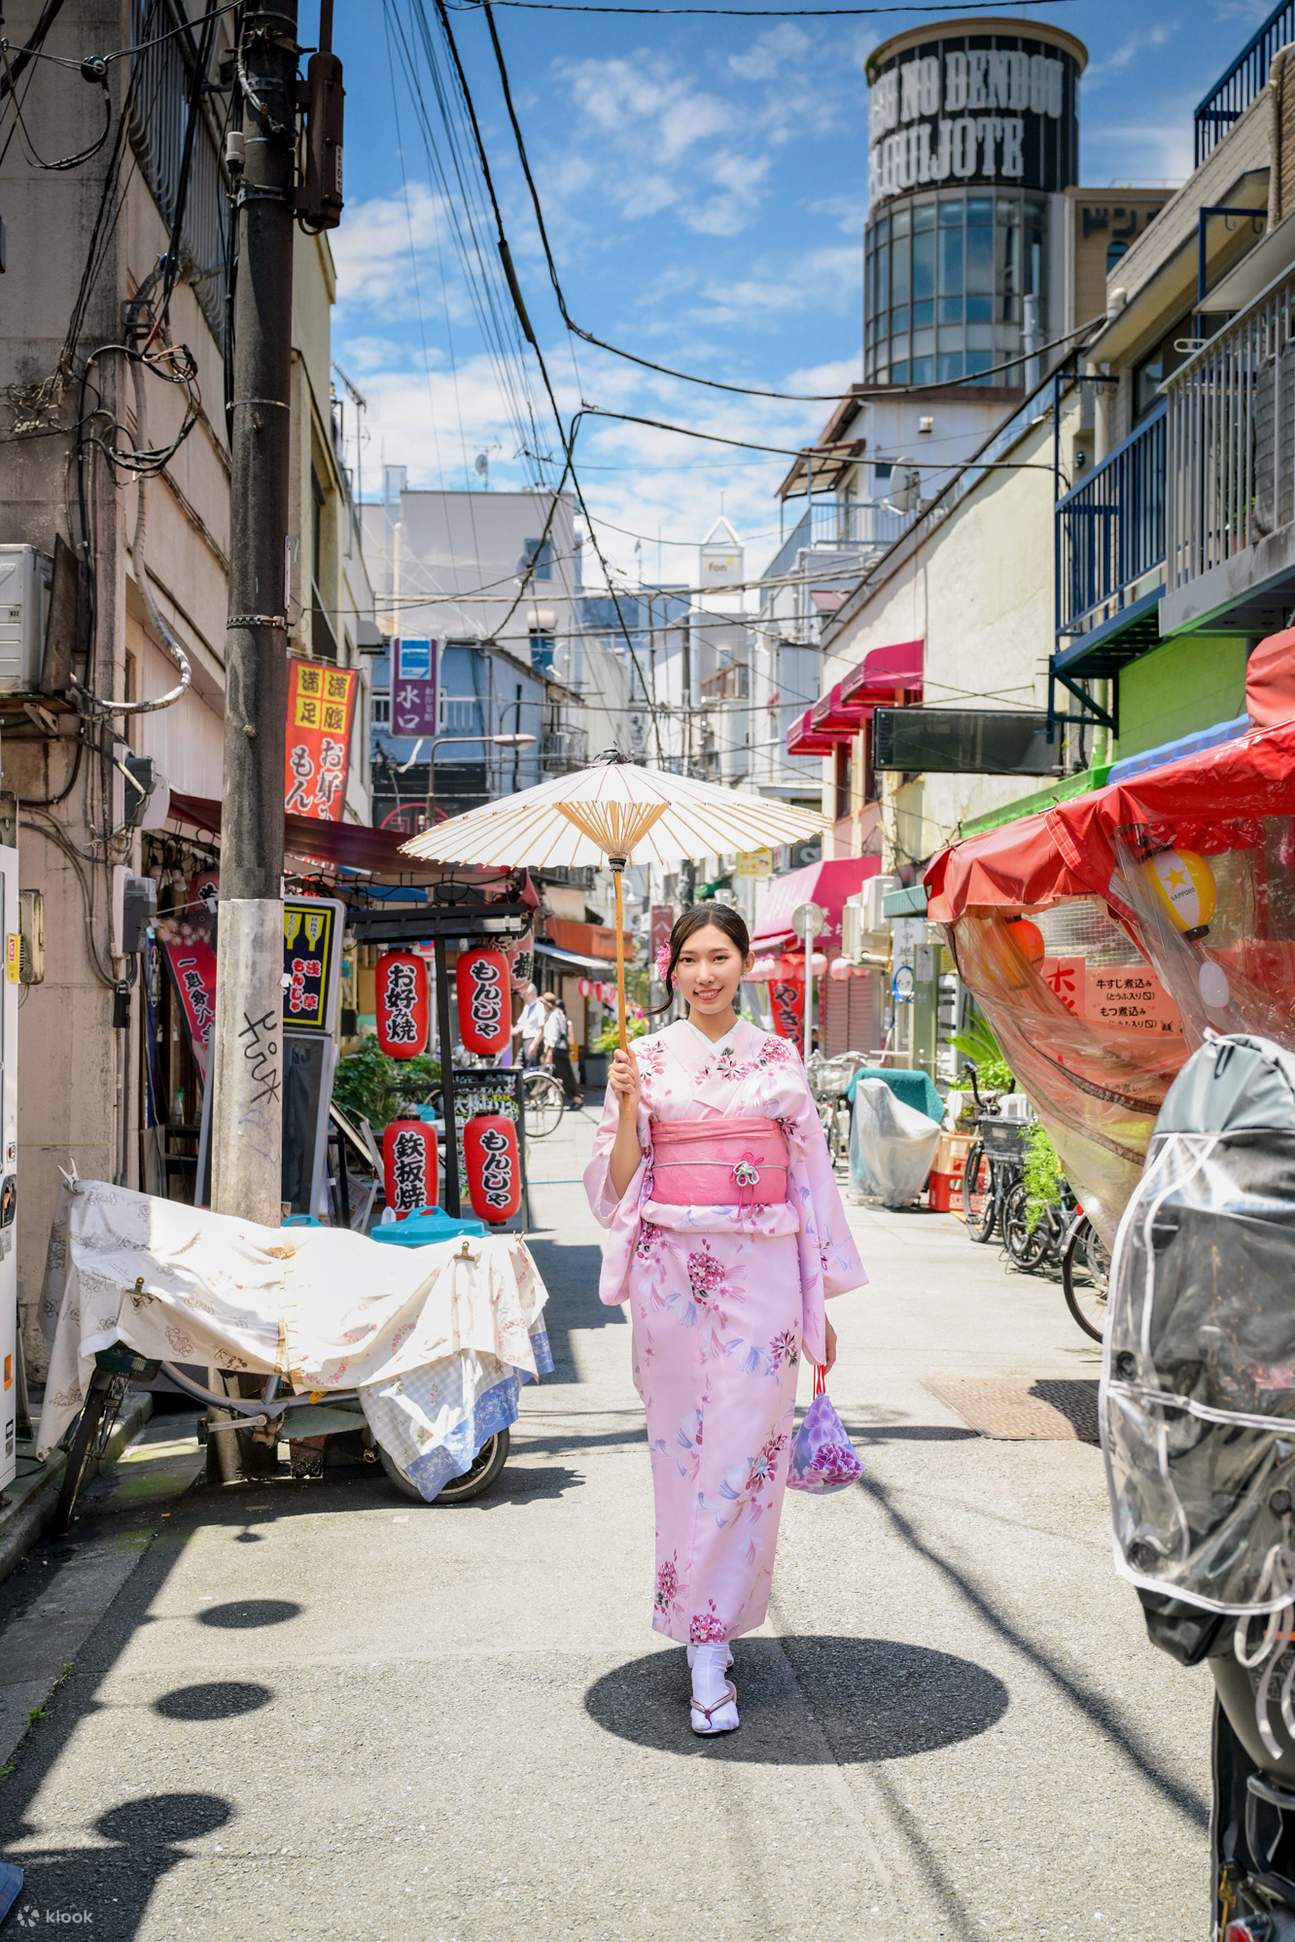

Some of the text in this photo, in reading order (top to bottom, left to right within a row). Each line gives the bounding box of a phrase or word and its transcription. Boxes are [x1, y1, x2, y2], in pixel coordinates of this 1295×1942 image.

[900, 55, 939, 123] NO
[1082, 207, 1160, 238] ドン
[396, 684, 421, 729] 水口
[284, 745, 314, 814] もん
[386, 964, 416, 1042] お好み焼
[1096, 978, 1153, 990] 牛すじ煮込み
[1100, 1006, 1147, 1017] もつ煮込み
[394, 1133, 425, 1210] 鉄板焼
